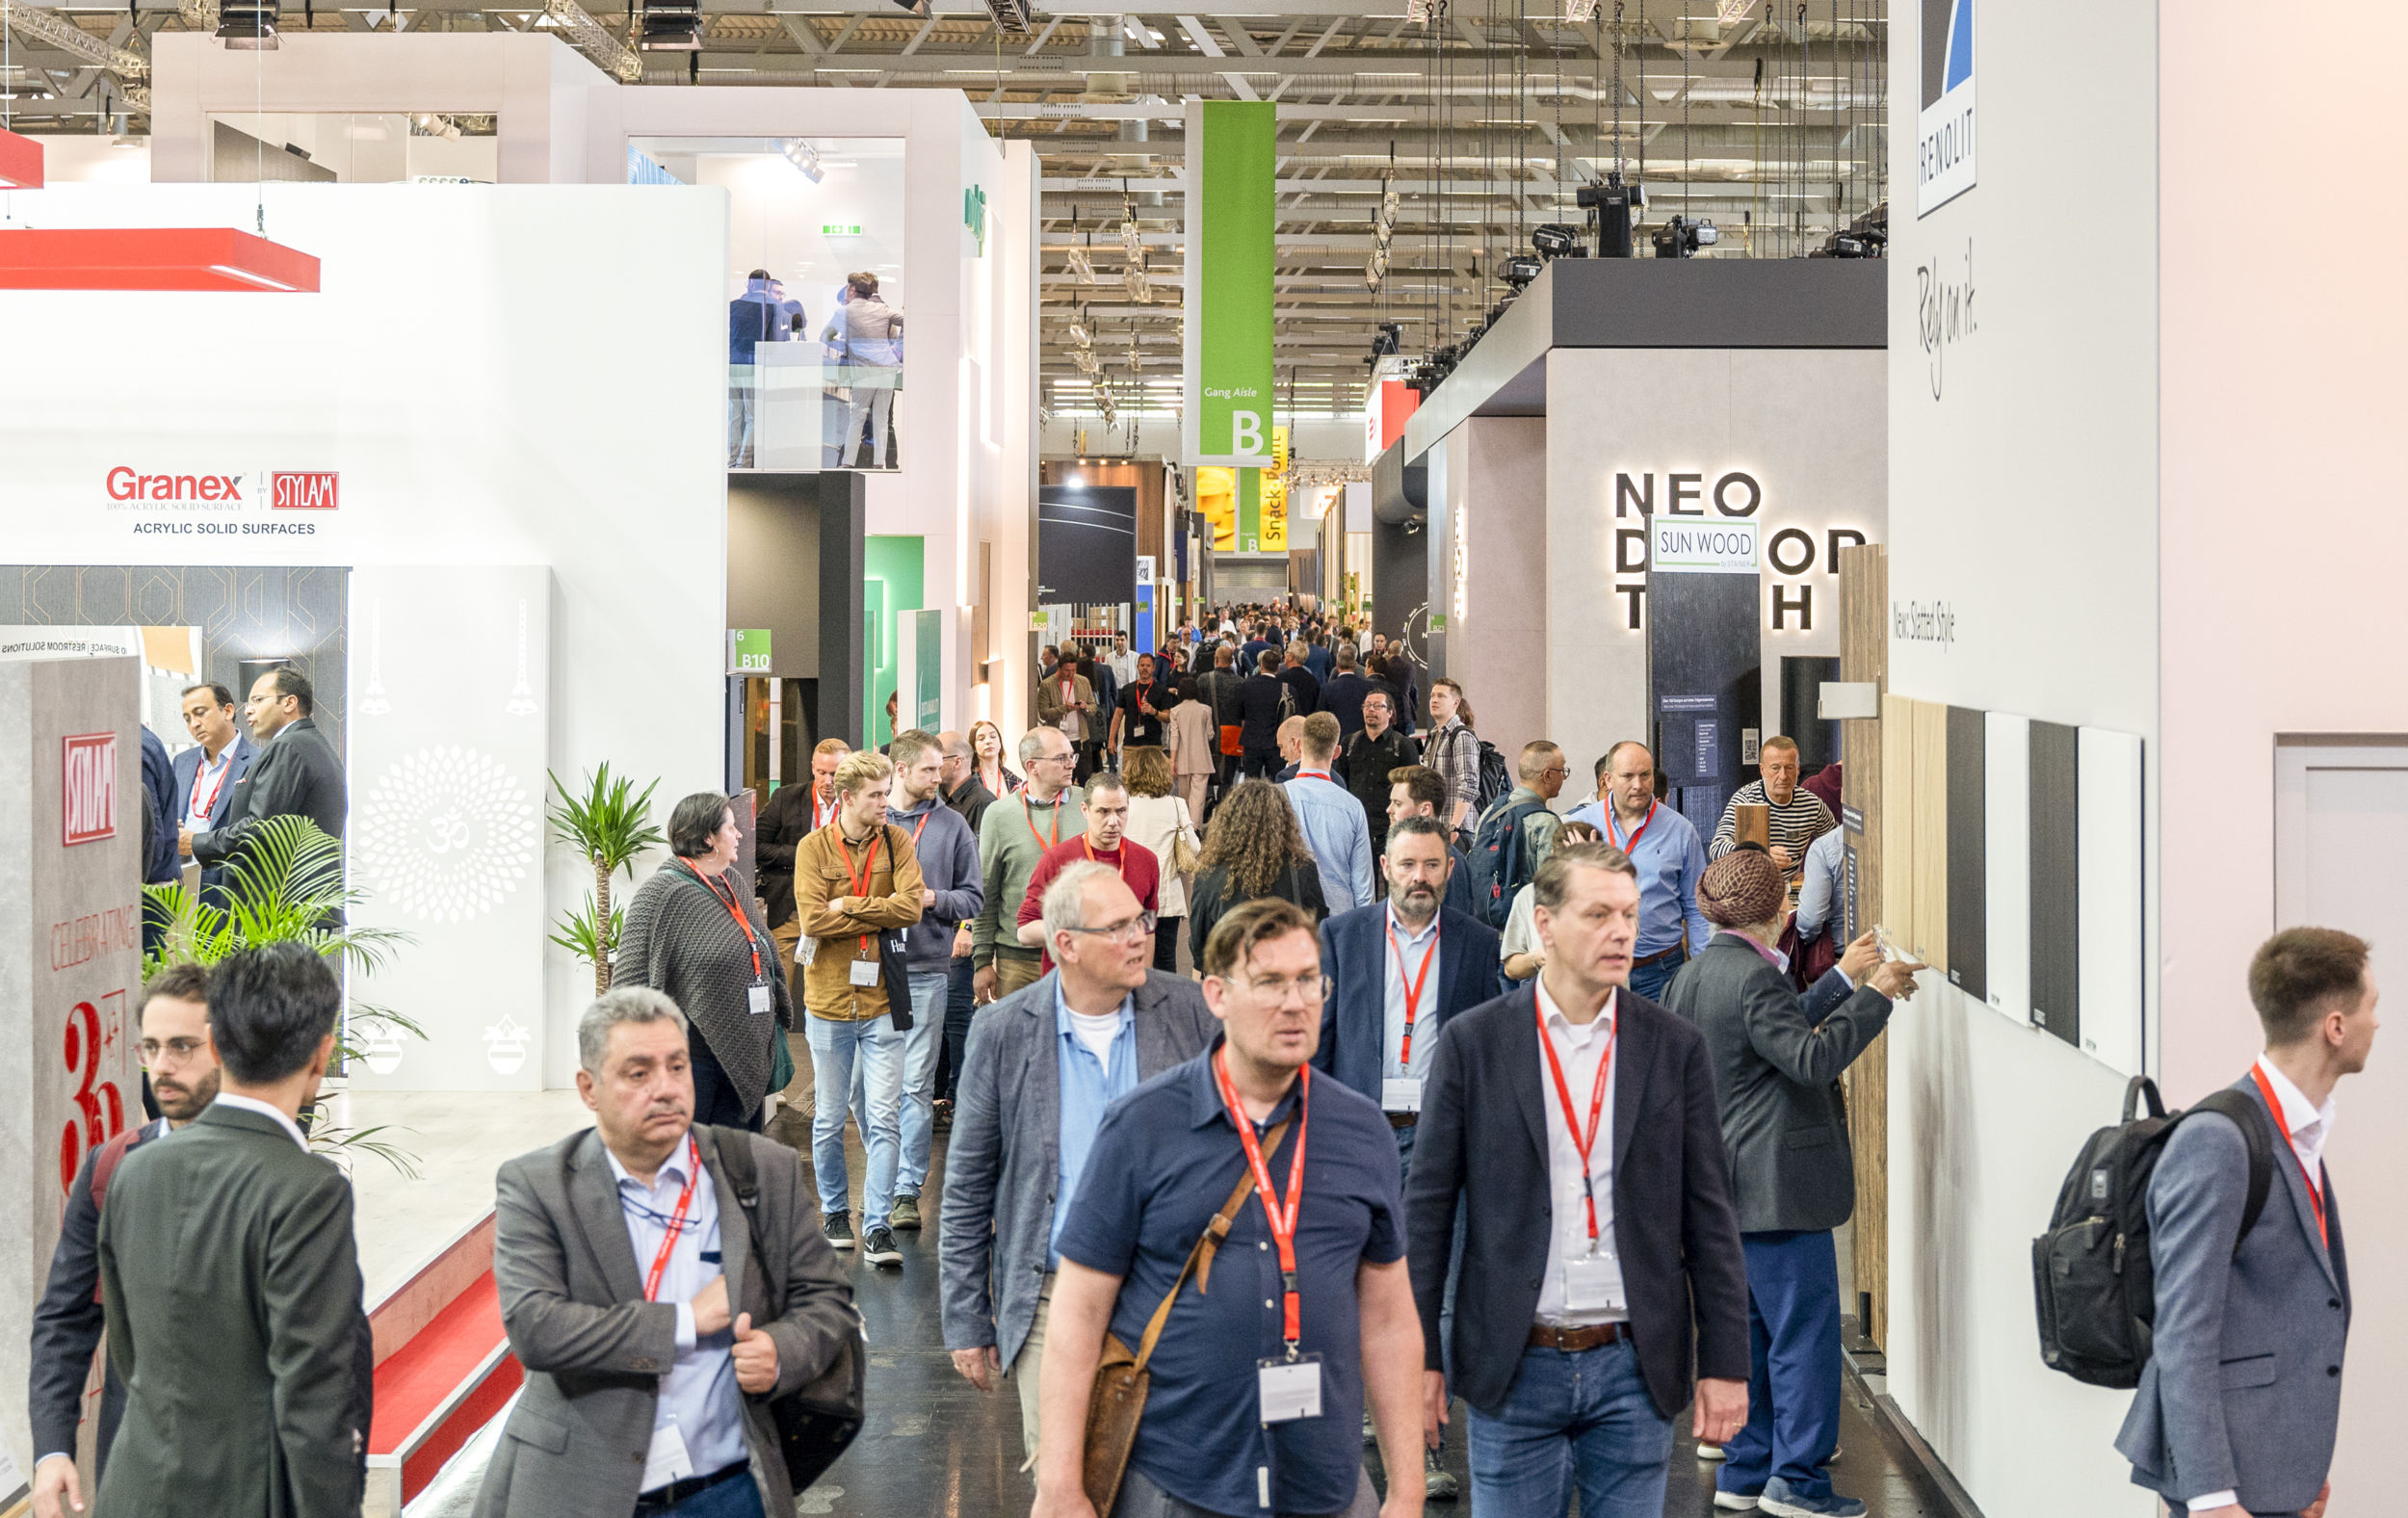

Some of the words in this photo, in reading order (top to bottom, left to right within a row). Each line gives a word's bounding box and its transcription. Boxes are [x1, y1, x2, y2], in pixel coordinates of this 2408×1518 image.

[1920, 107, 1974, 186] RENOLIT
[1917, 254, 1943, 403] Rely
[1947, 284, 1960, 344] on
[1964, 235, 1977, 336] it.
[1204, 386, 1231, 400] Gang
[1233, 386, 1257, 398] Aisle
[1233, 410, 1264, 456] B
[106, 465, 243, 501] Granex
[257, 486, 268, 495] BY
[275, 474, 335, 507] STYLAM
[1615, 472, 1762, 517] NEO
[107, 503, 129, 511] 100%
[130, 503, 170, 511] ACRYLIC
[171, 503, 199, 511] SOLID
[201, 503, 243, 511] SURFACE
[1266, 490, 1281, 540] Snack
[133, 523, 194, 535] ACRYLIC
[196, 523, 239, 535] SOLID
[242, 523, 316, 535] SURFACES
[1248, 538, 1258, 552] B
[1661, 531, 1692, 554] SUN
[1696, 533, 1752, 556] WOOD
[736, 630, 745, 641] 6
[1911, 600, 1935, 641] Slatted
[1936, 600, 1955, 655] Style
[742, 653, 770, 668] B10
